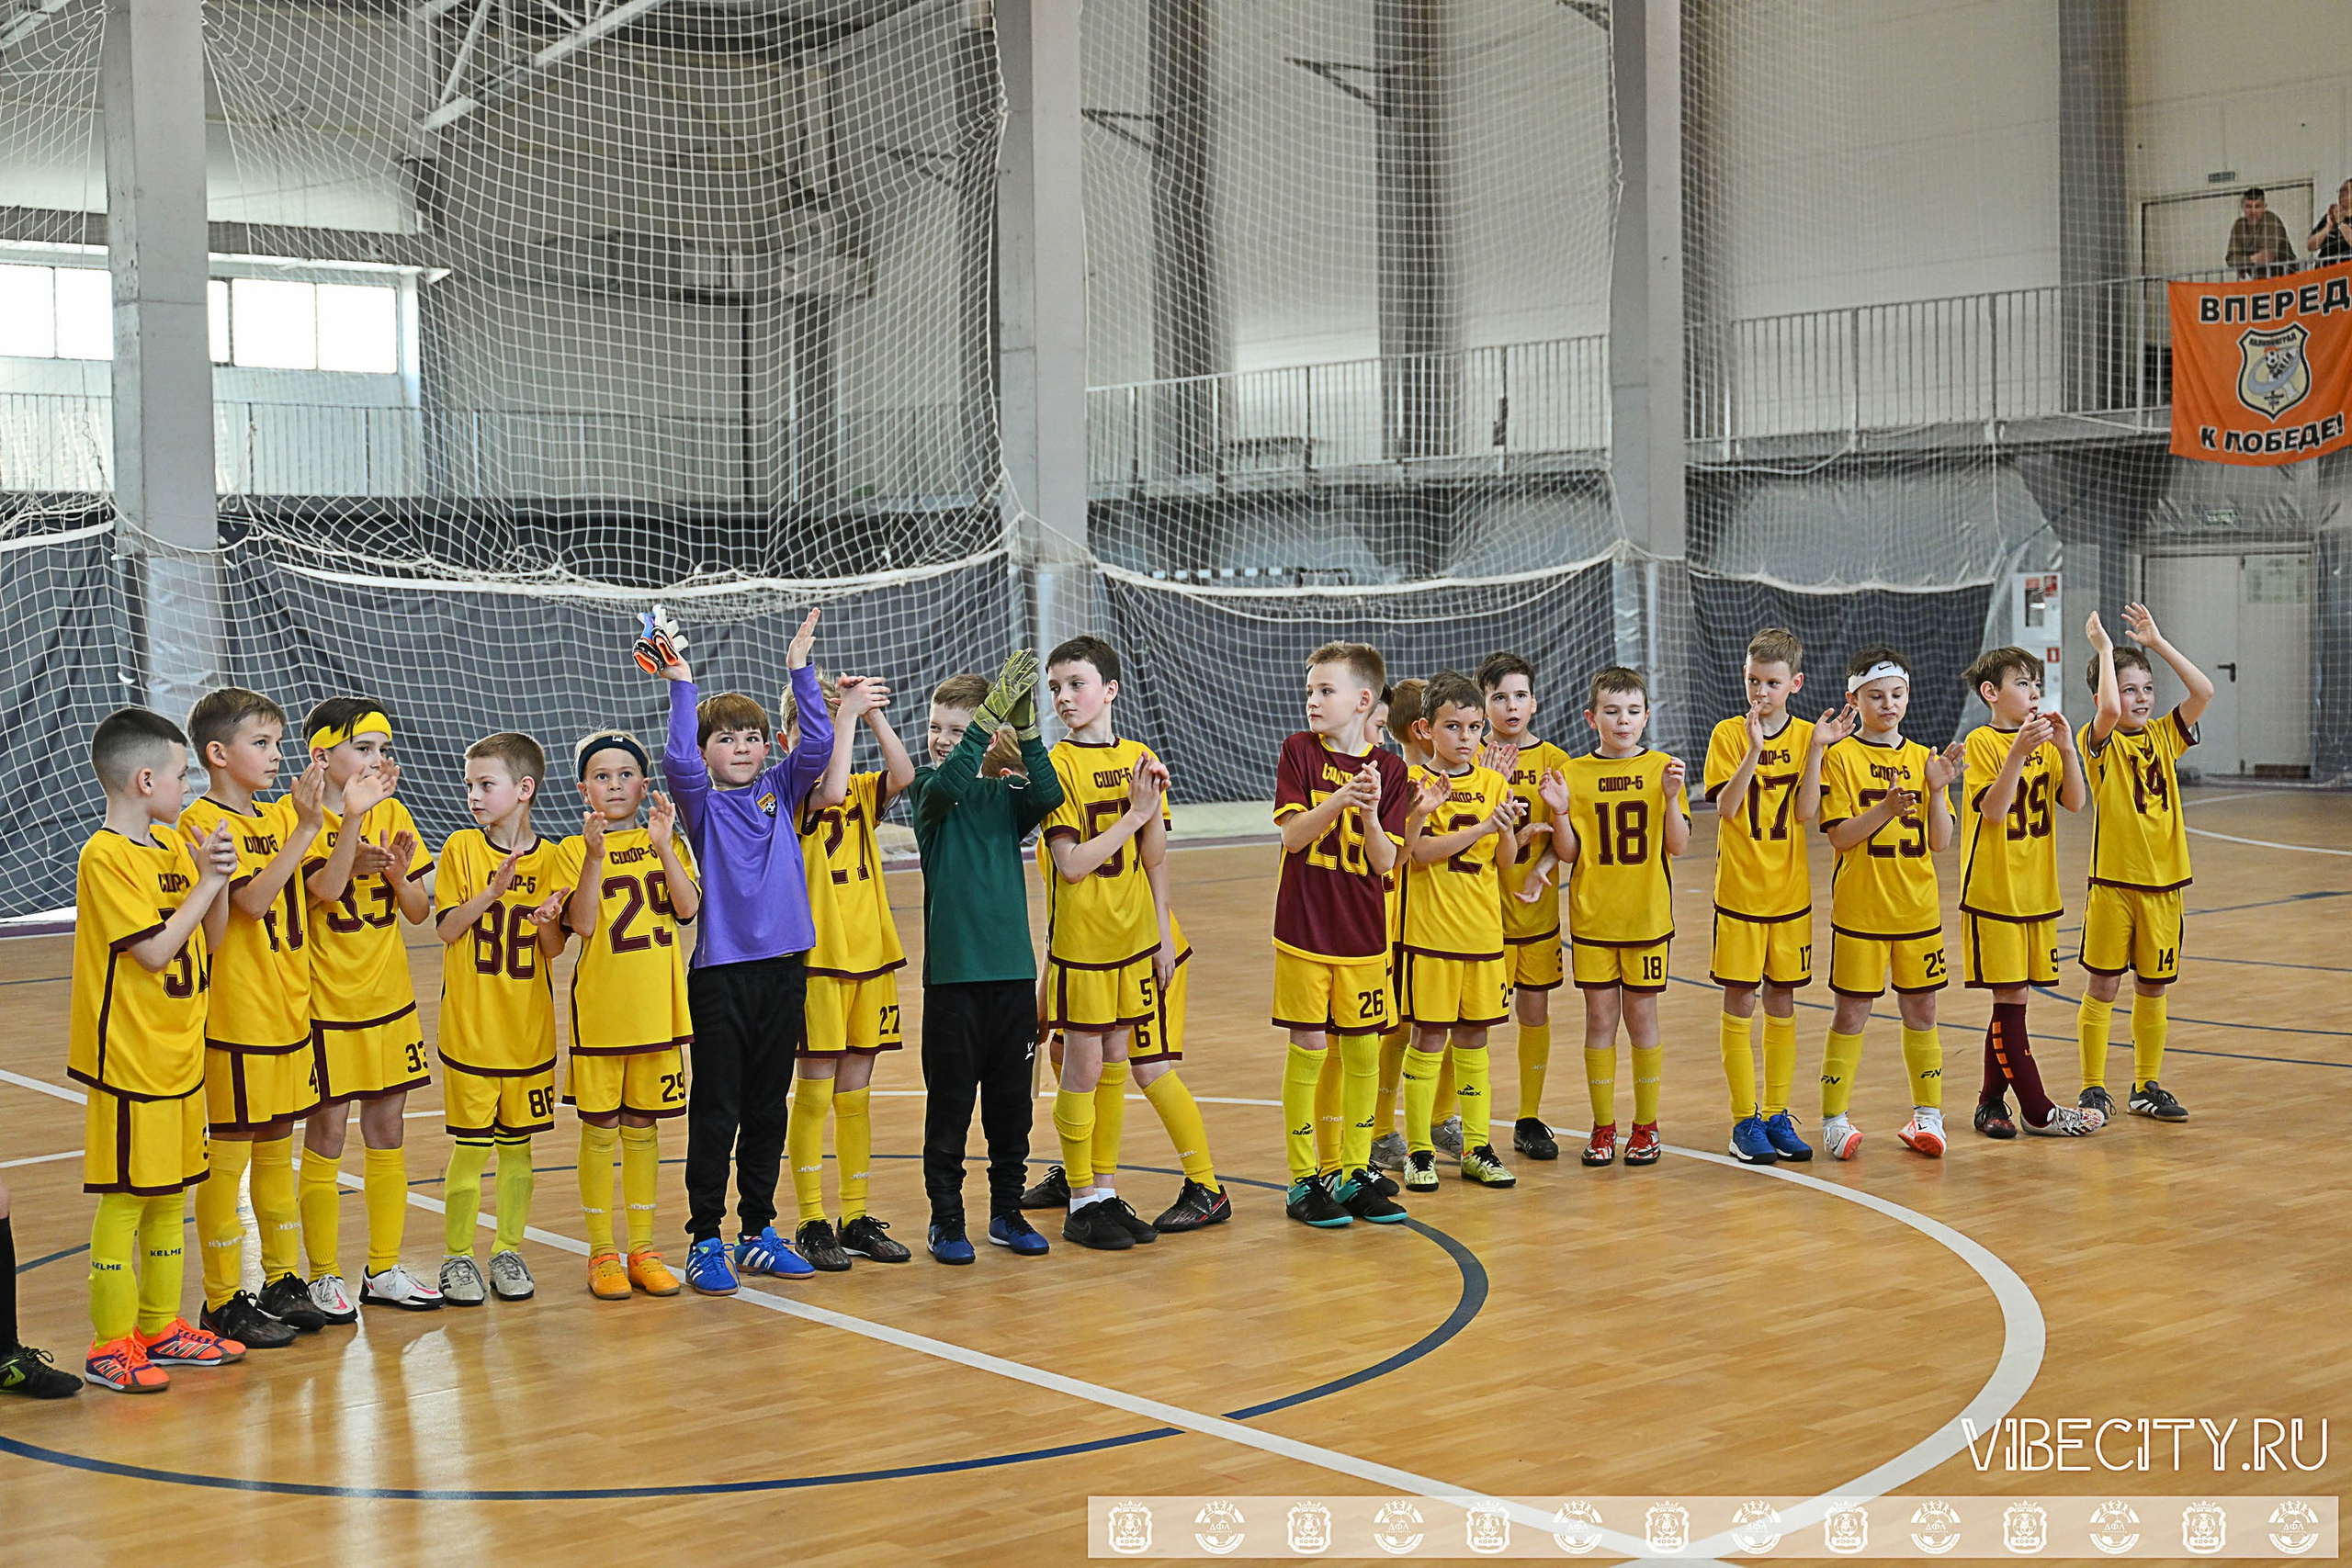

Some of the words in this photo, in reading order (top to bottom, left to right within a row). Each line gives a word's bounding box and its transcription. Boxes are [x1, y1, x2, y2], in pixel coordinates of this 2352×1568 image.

[2199, 277, 2351, 324] ВПЕРЕД
[2200, 427, 2217, 449] К
[2223, 412, 2344, 454] ПОБЕДЕ!
[1758, 750, 1791, 766] ШОР-5
[1508, 770, 1537, 785] ОР-5
[1599, 775, 1644, 793] СШОР-5
[1748, 773, 1800, 840] 17
[1594, 800, 1648, 865] 18
[1859, 788, 1927, 858] 25
[487, 870, 537, 895] СОР-5
[602, 870, 673, 954] 29
[473, 900, 540, 979] 86
[1643, 956, 1662, 980] 18
[2157, 947, 2175, 972] 14
[1358, 988, 1384, 1019] 26
[879, 1005, 900, 1035] 27
[661, 1072, 686, 1102] 29
[92, 1260, 121, 1271] KELME
